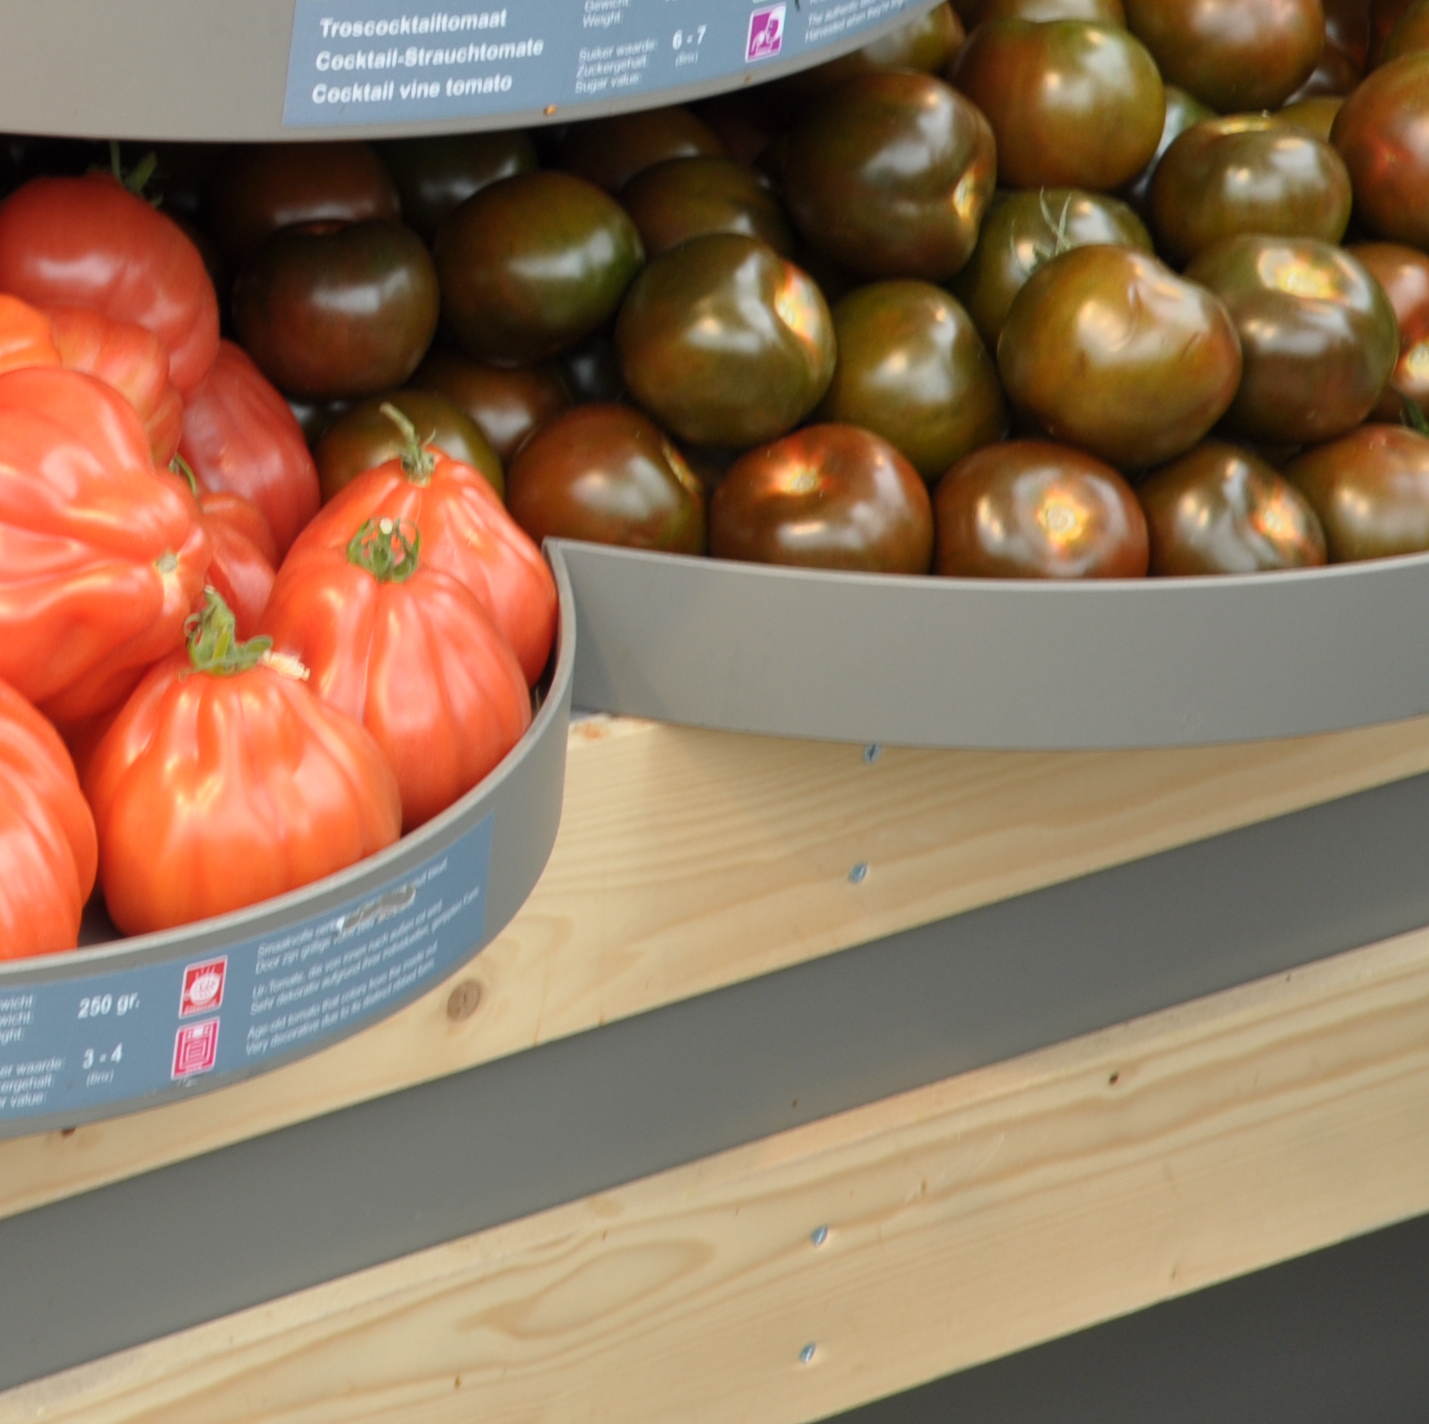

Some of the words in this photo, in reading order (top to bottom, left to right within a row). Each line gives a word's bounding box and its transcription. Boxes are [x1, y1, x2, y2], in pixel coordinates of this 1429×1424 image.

[319, 11, 508, 38] Troscocktailtomaat
[671, 29, 683, 51] 6
[696, 24, 708, 45] 7
[314, 40, 545, 71] Cocktail-Strauchtomate
[311, 81, 395, 104] Cocktail
[398, 80, 441, 100] vine
[445, 74, 513, 97] tomato
[77, 994, 113, 1019] 250
[116, 993, 140, 1016] gr.
[82, 1048, 95, 1070] 3
[110, 1042, 123, 1063] 4
